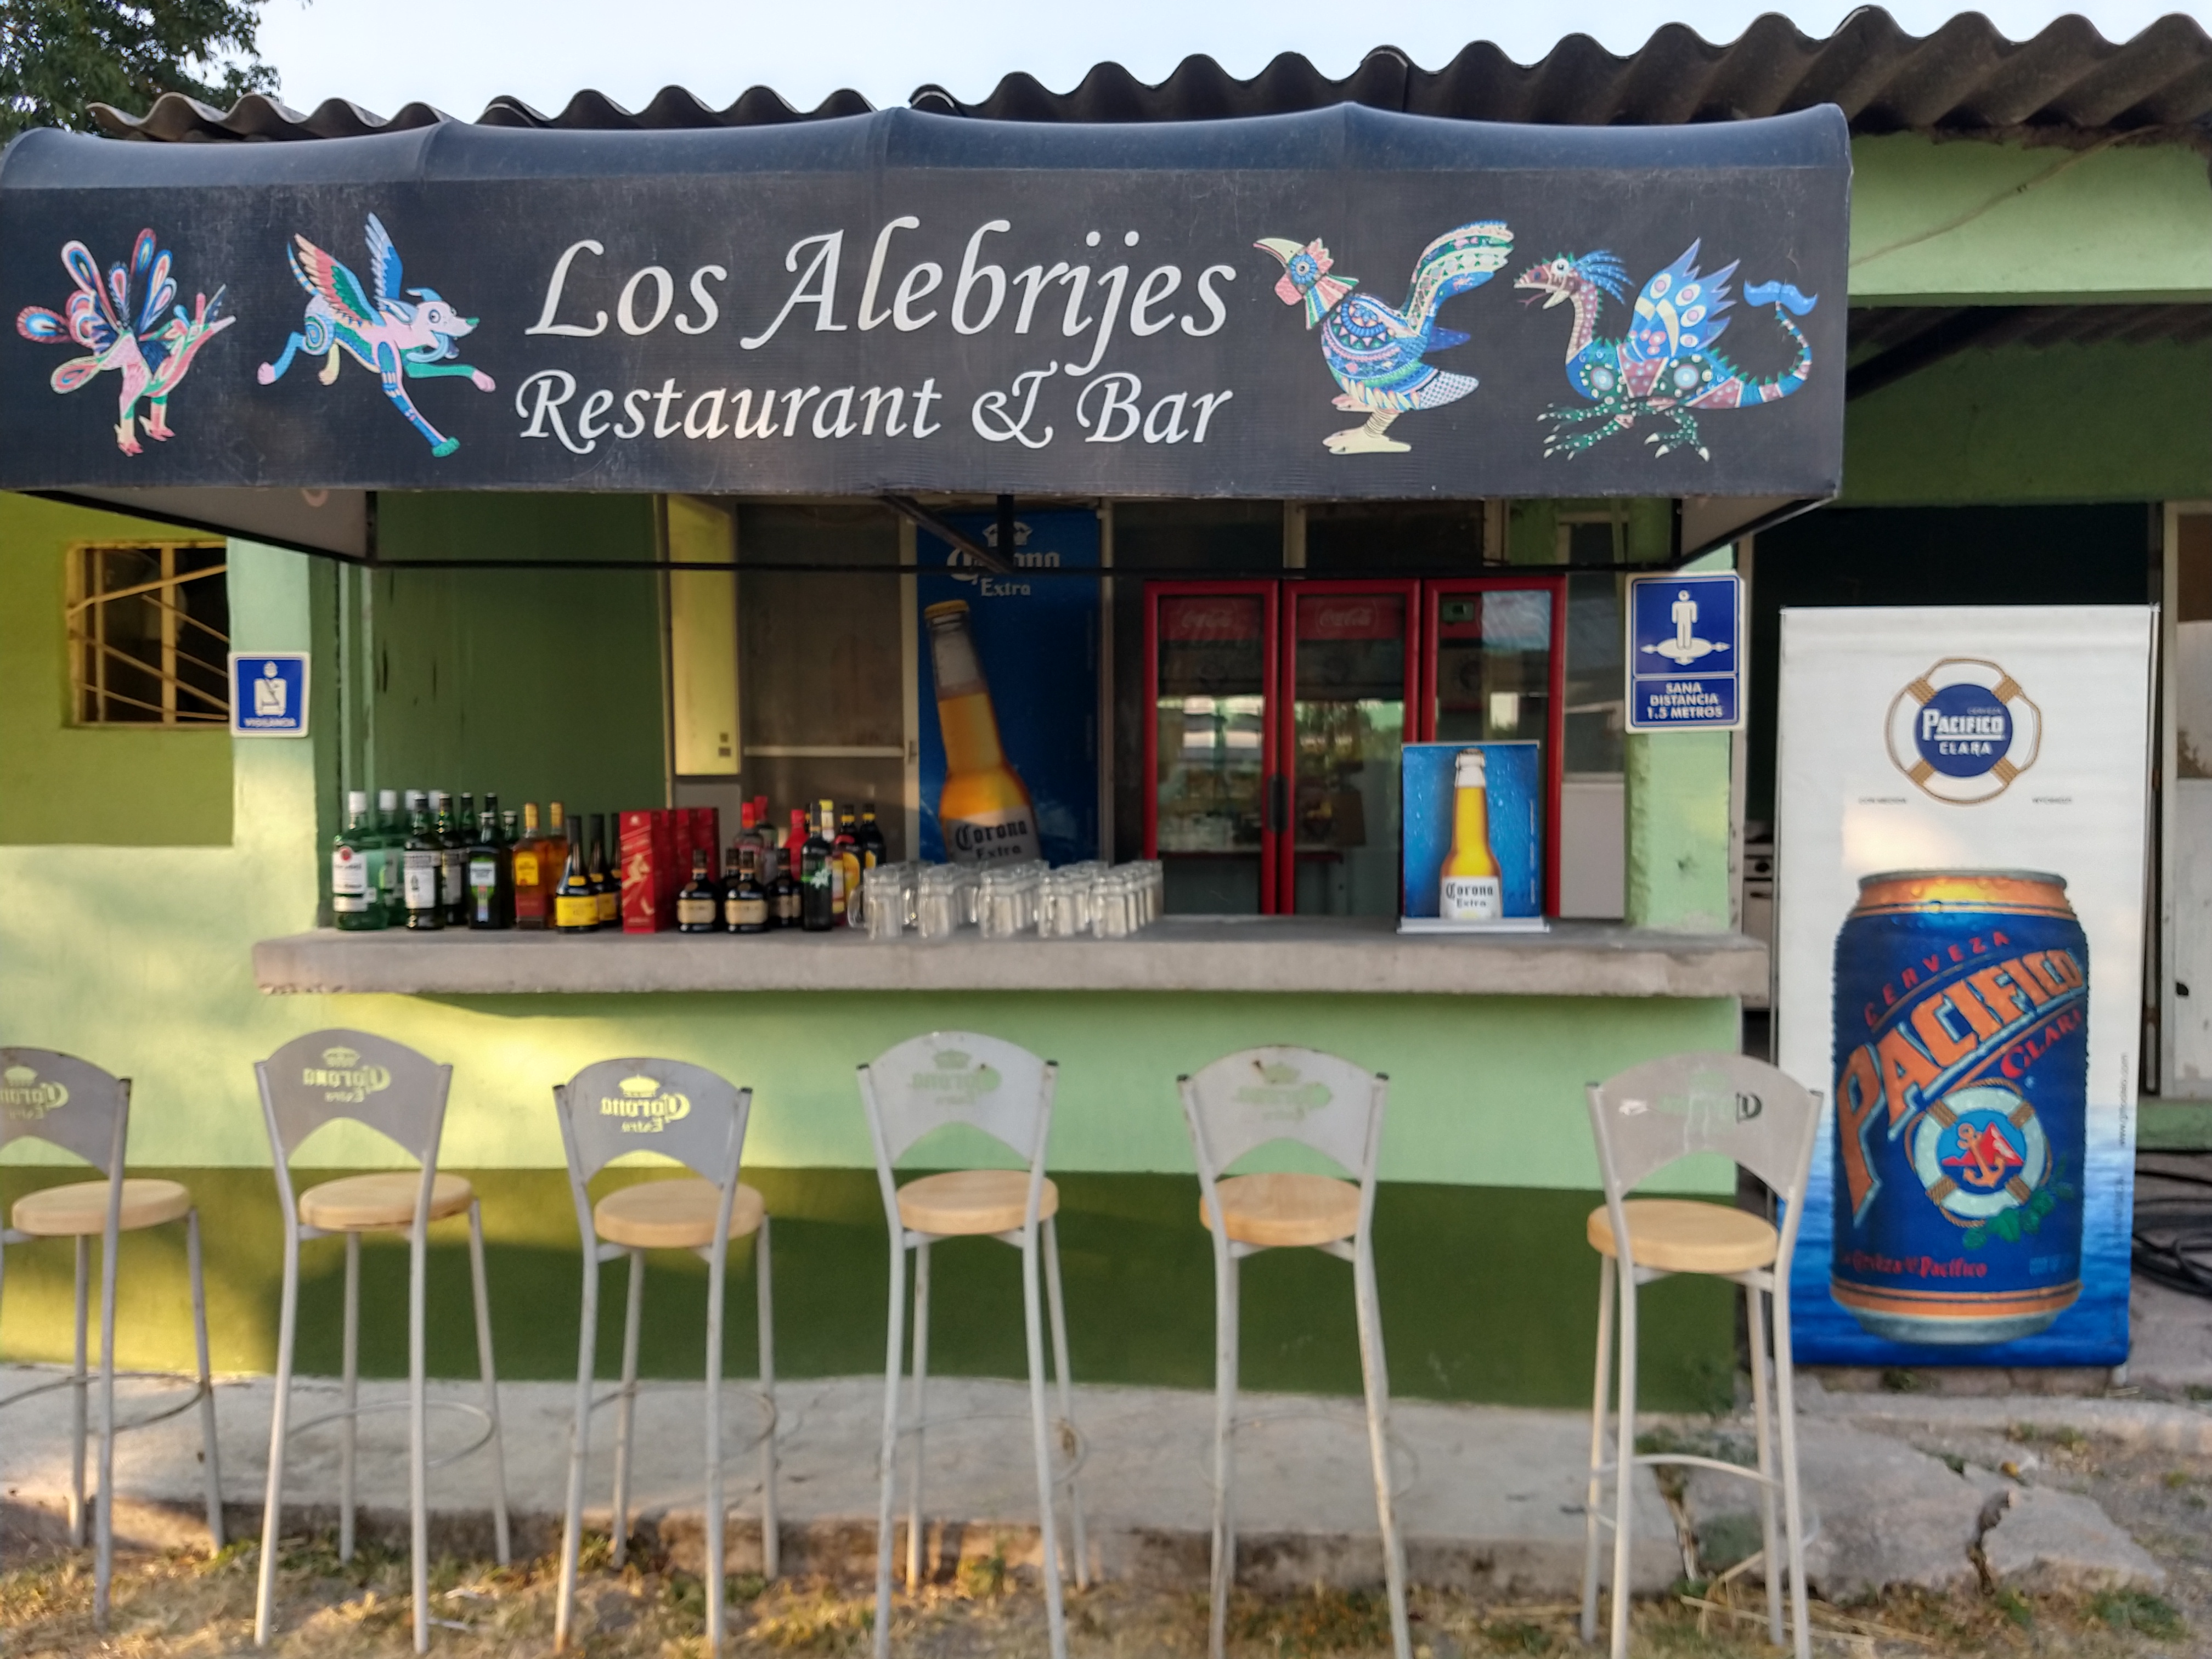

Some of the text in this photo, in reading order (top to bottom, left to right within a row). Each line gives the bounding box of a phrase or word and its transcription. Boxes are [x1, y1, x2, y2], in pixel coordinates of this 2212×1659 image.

[524, 216, 1237, 376] Los Alebrijes
[515, 360, 1233, 454] Restaurant & Bar
[946, 548, 1060, 586] Cona
[980, 577, 1031, 597] Extra
[1649, 693, 1719, 707] DISTANCIA
[1665, 681, 1702, 695] SANA
[1647, 705, 1723, 720] 1.5 METROS
[1922, 708, 2006, 741] PACIFICO
[1939, 741, 1993, 757] CLARA
[955, 820, 1028, 851] Corona
[1445, 881, 1494, 900] Corona
[1455, 897, 1487, 908] Extra
[1865, 930, 2010, 1026] CERVEZA
[1836, 948, 2087, 1224] PACIFICO
